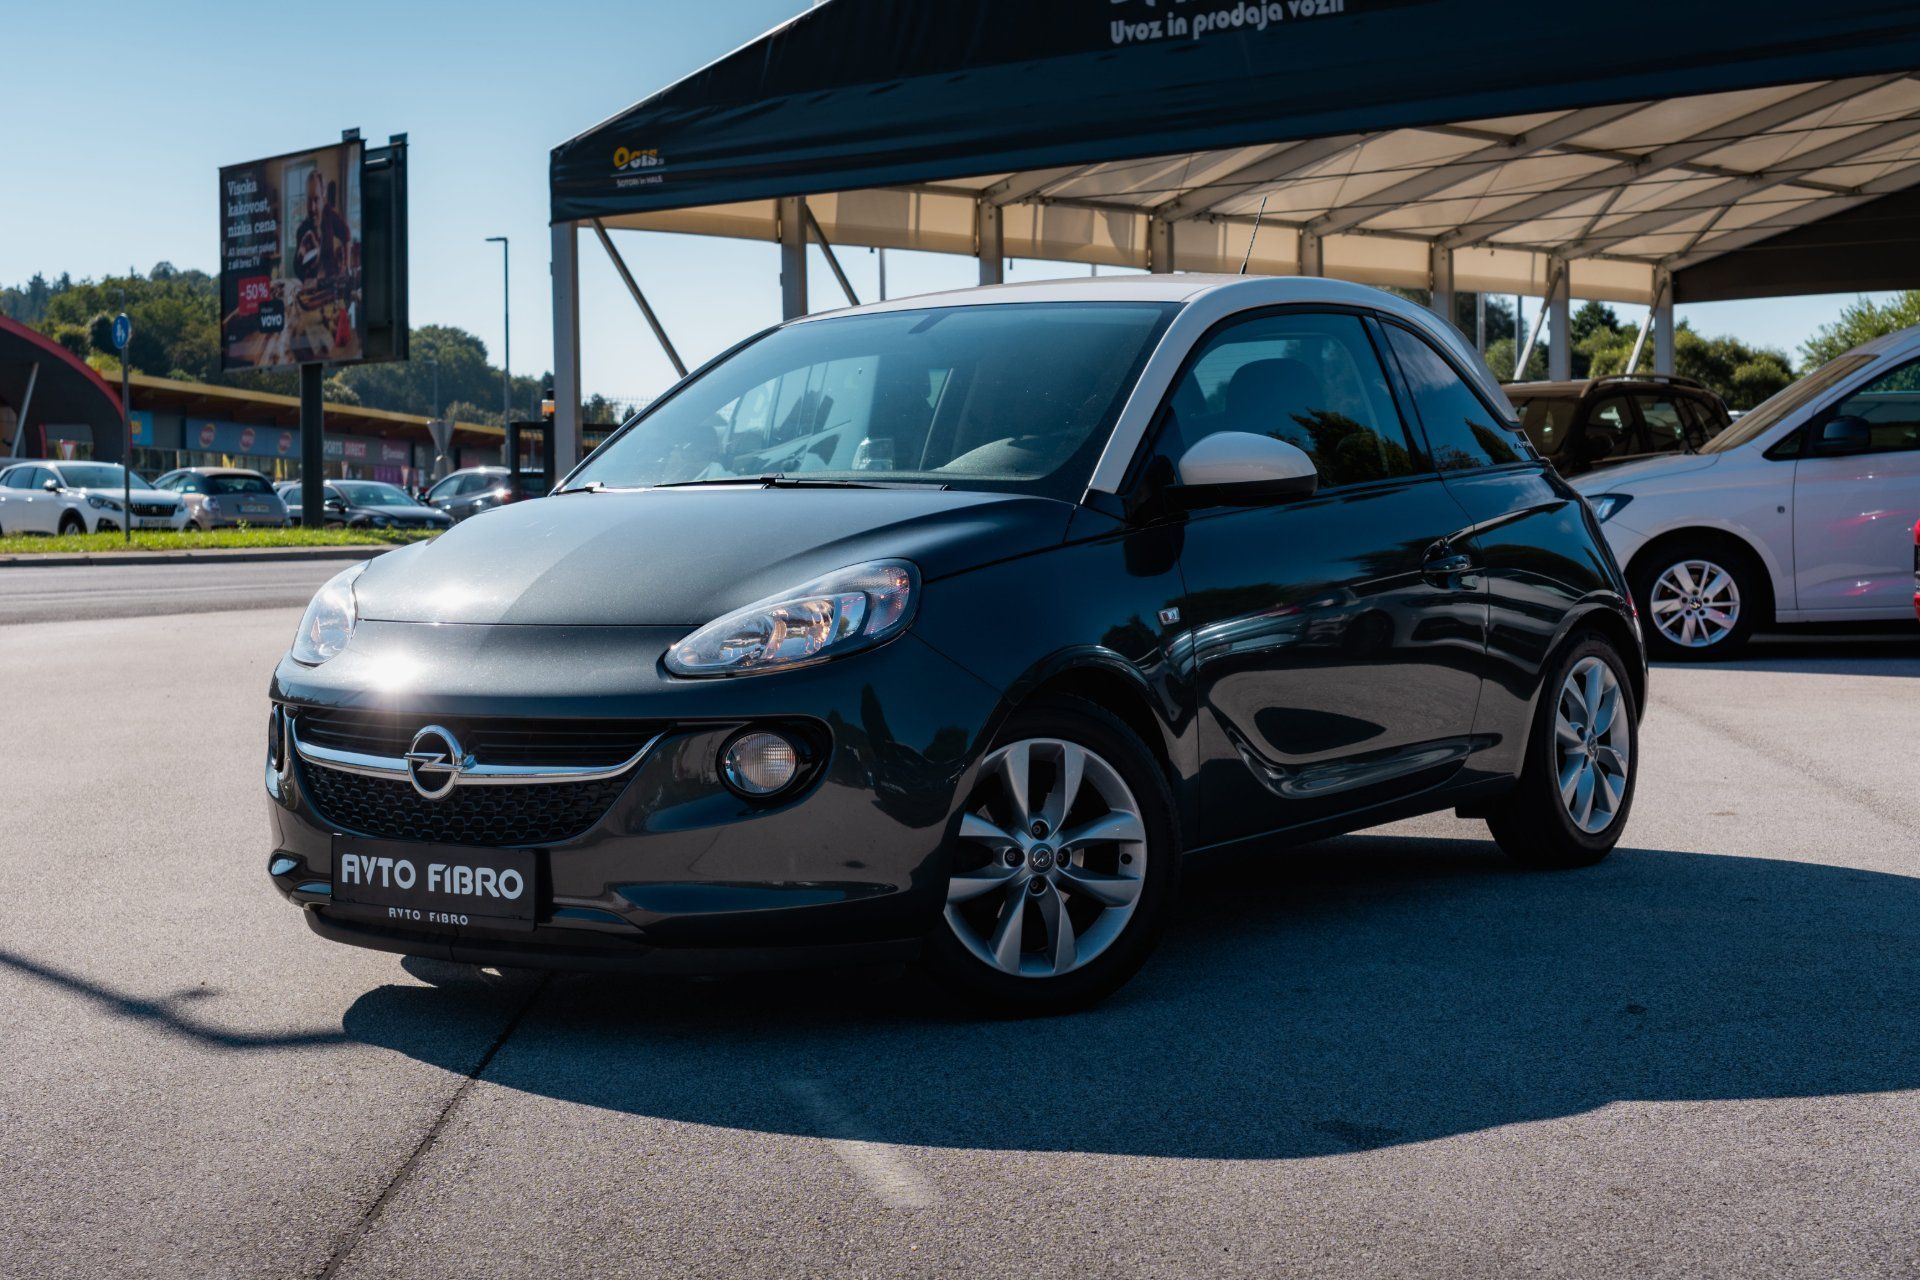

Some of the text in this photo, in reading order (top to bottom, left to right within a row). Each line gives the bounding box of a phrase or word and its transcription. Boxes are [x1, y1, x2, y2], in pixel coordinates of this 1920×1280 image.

[1110, 18, 1163, 44] Uvoz
[1167, 11, 1188, 36] in
[1193, 2, 1283, 40] prodaja
[228, 179, 257, 196] Visoka
[228, 198, 271, 217] kakovost,
[228, 219, 277, 238] nizka cena
[323, 440, 343, 455] PORTS
[341, 853, 524, 900] AVTO FIBRO
[388, 907, 469, 926] AVTO FIBRO
